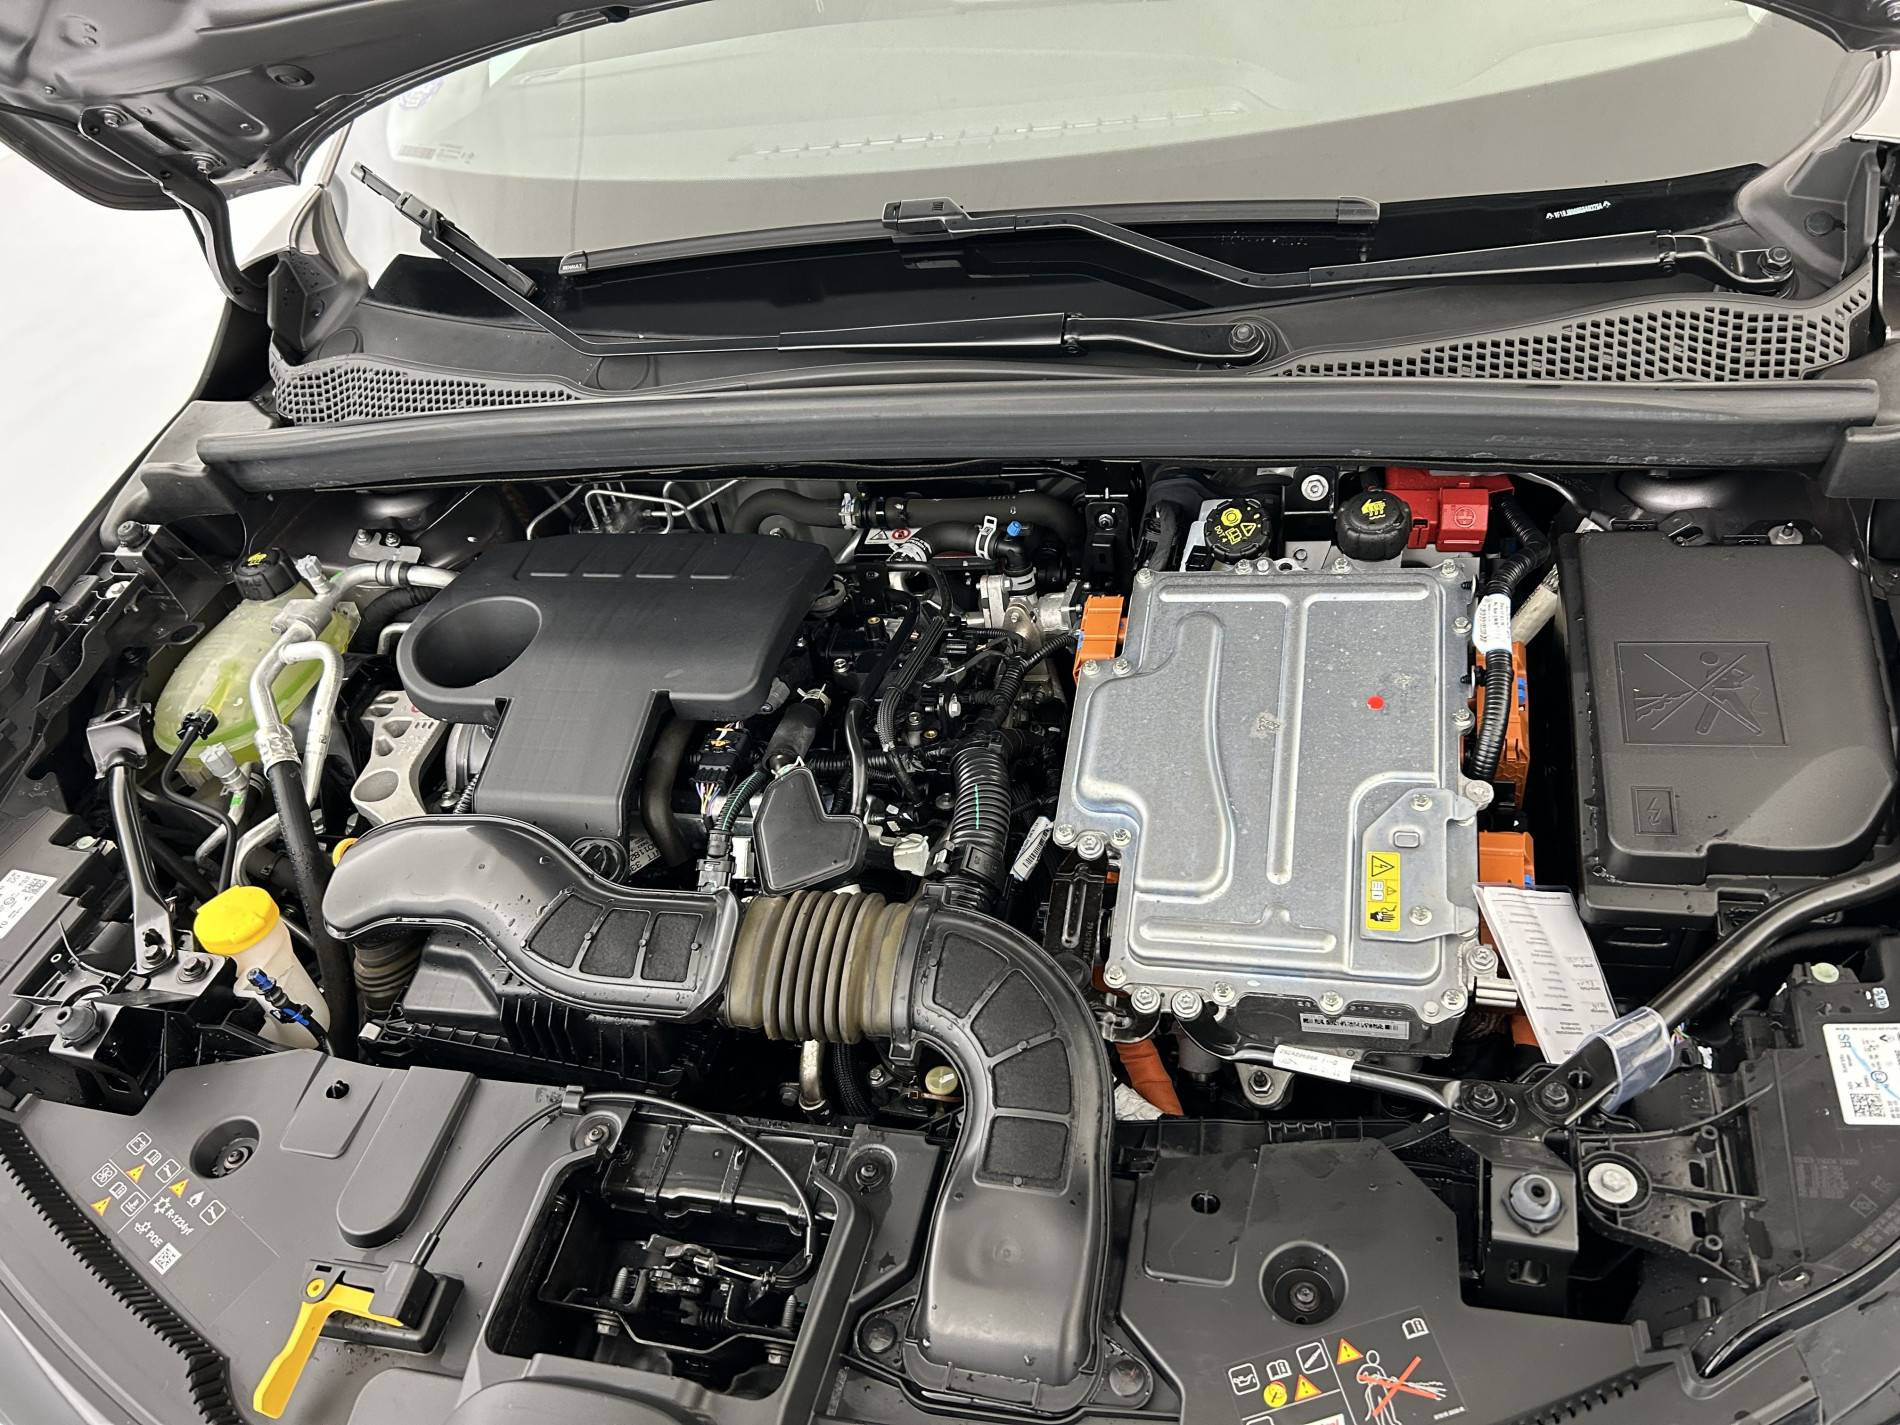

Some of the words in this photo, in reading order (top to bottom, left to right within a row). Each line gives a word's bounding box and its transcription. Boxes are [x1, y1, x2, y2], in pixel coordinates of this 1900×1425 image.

[1214, 525, 1225, 538] DOT
[165, 1208, 195, 1236] R-1234yf
[146, 1230, 164, 1248] POE
